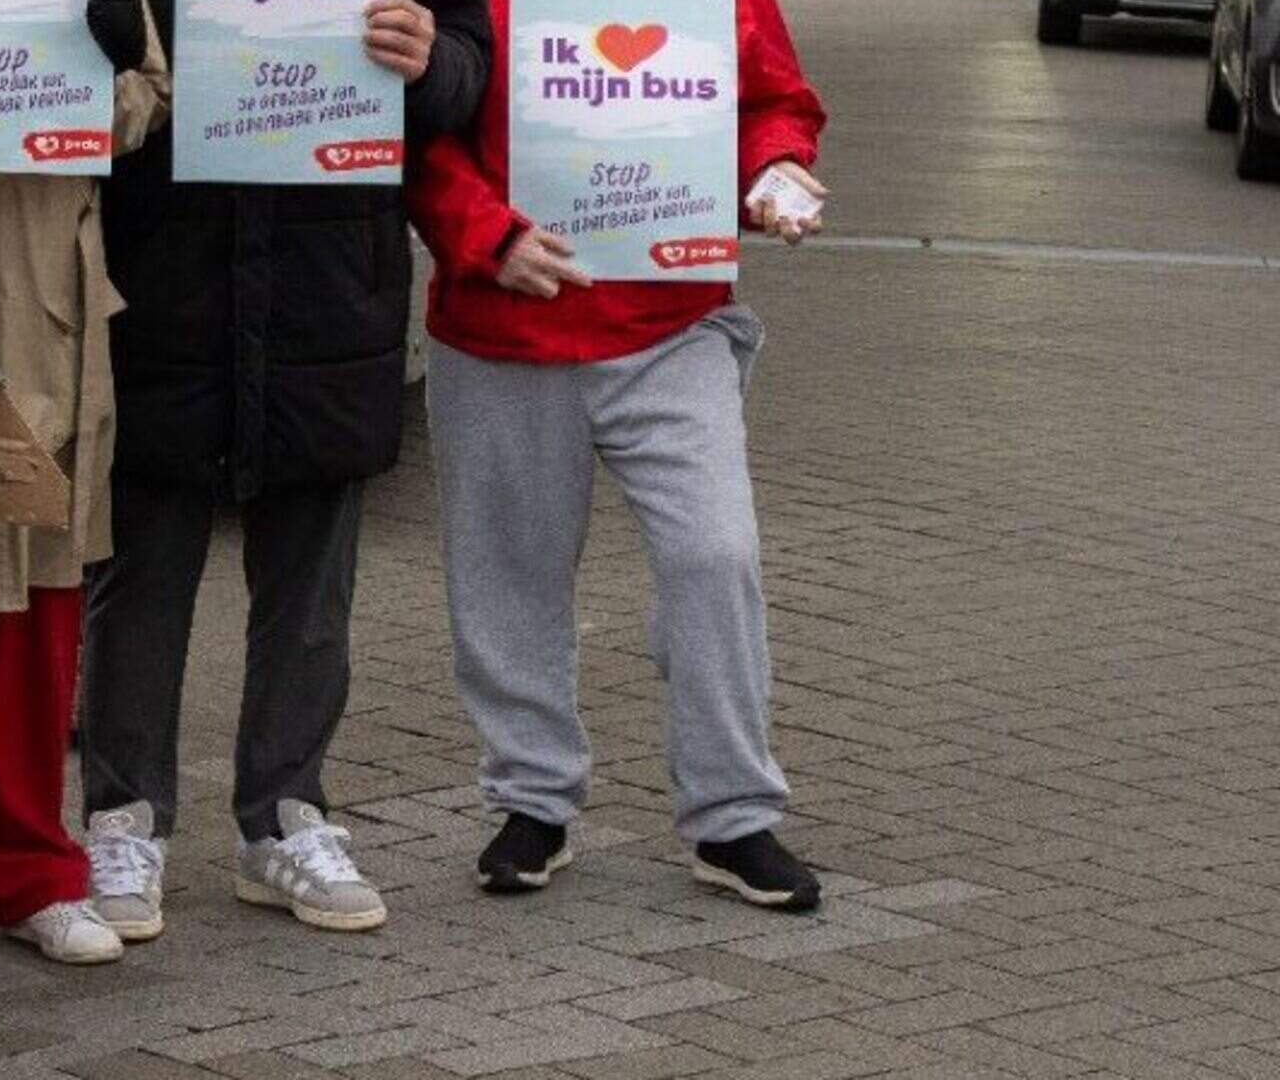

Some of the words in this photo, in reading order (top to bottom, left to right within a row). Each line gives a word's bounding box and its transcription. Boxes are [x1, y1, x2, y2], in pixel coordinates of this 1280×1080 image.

[542, 37, 580, 65] Ik
[543, 69, 631, 108] mijn
[641, 71, 720, 101] bus
